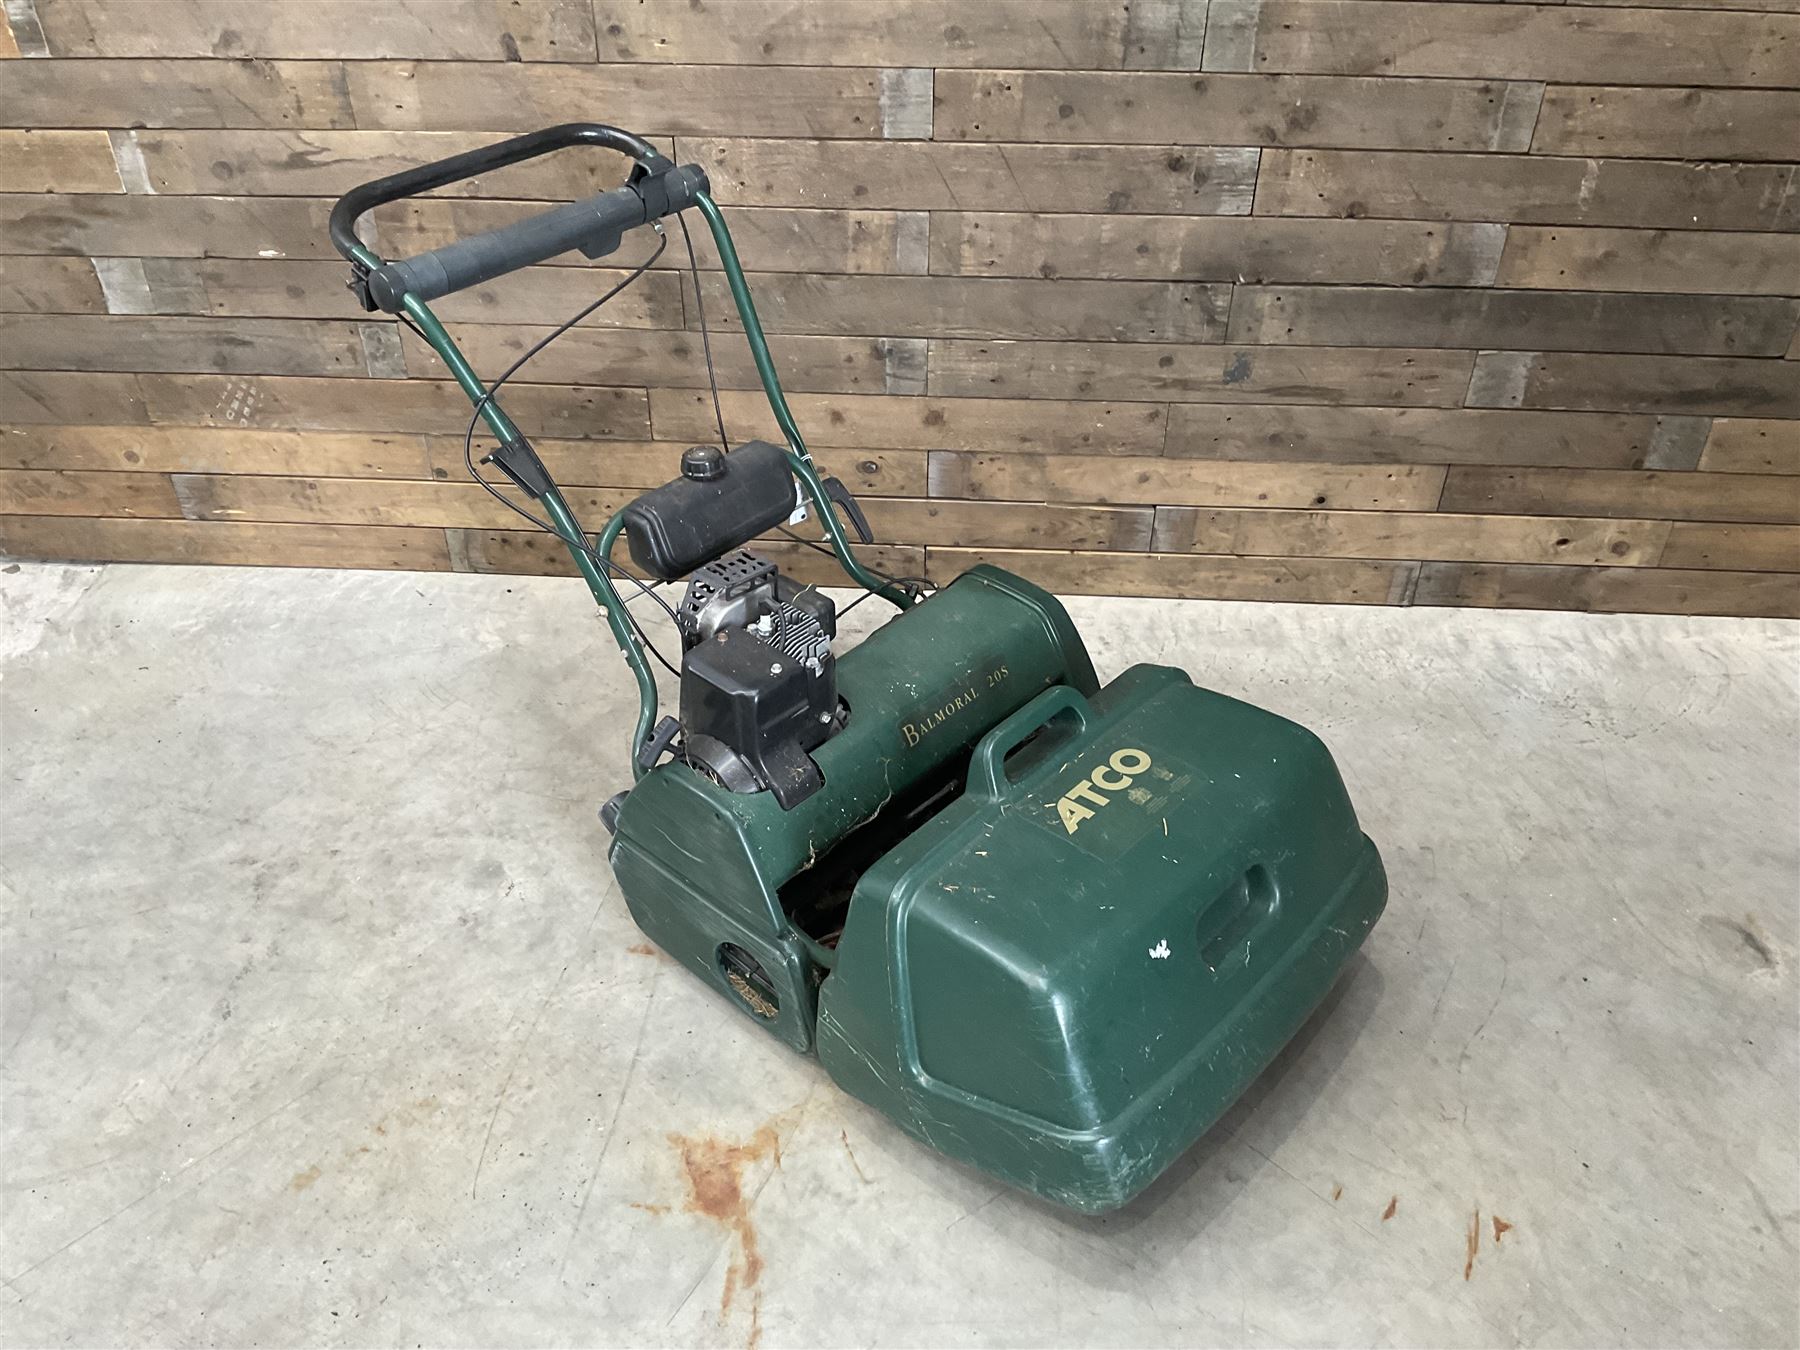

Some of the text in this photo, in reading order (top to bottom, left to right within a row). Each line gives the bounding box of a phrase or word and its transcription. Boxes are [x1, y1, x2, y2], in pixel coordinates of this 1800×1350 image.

[902, 665, 1009, 748] BALMORAL 20S
[1056, 748, 1152, 835] ATCO
